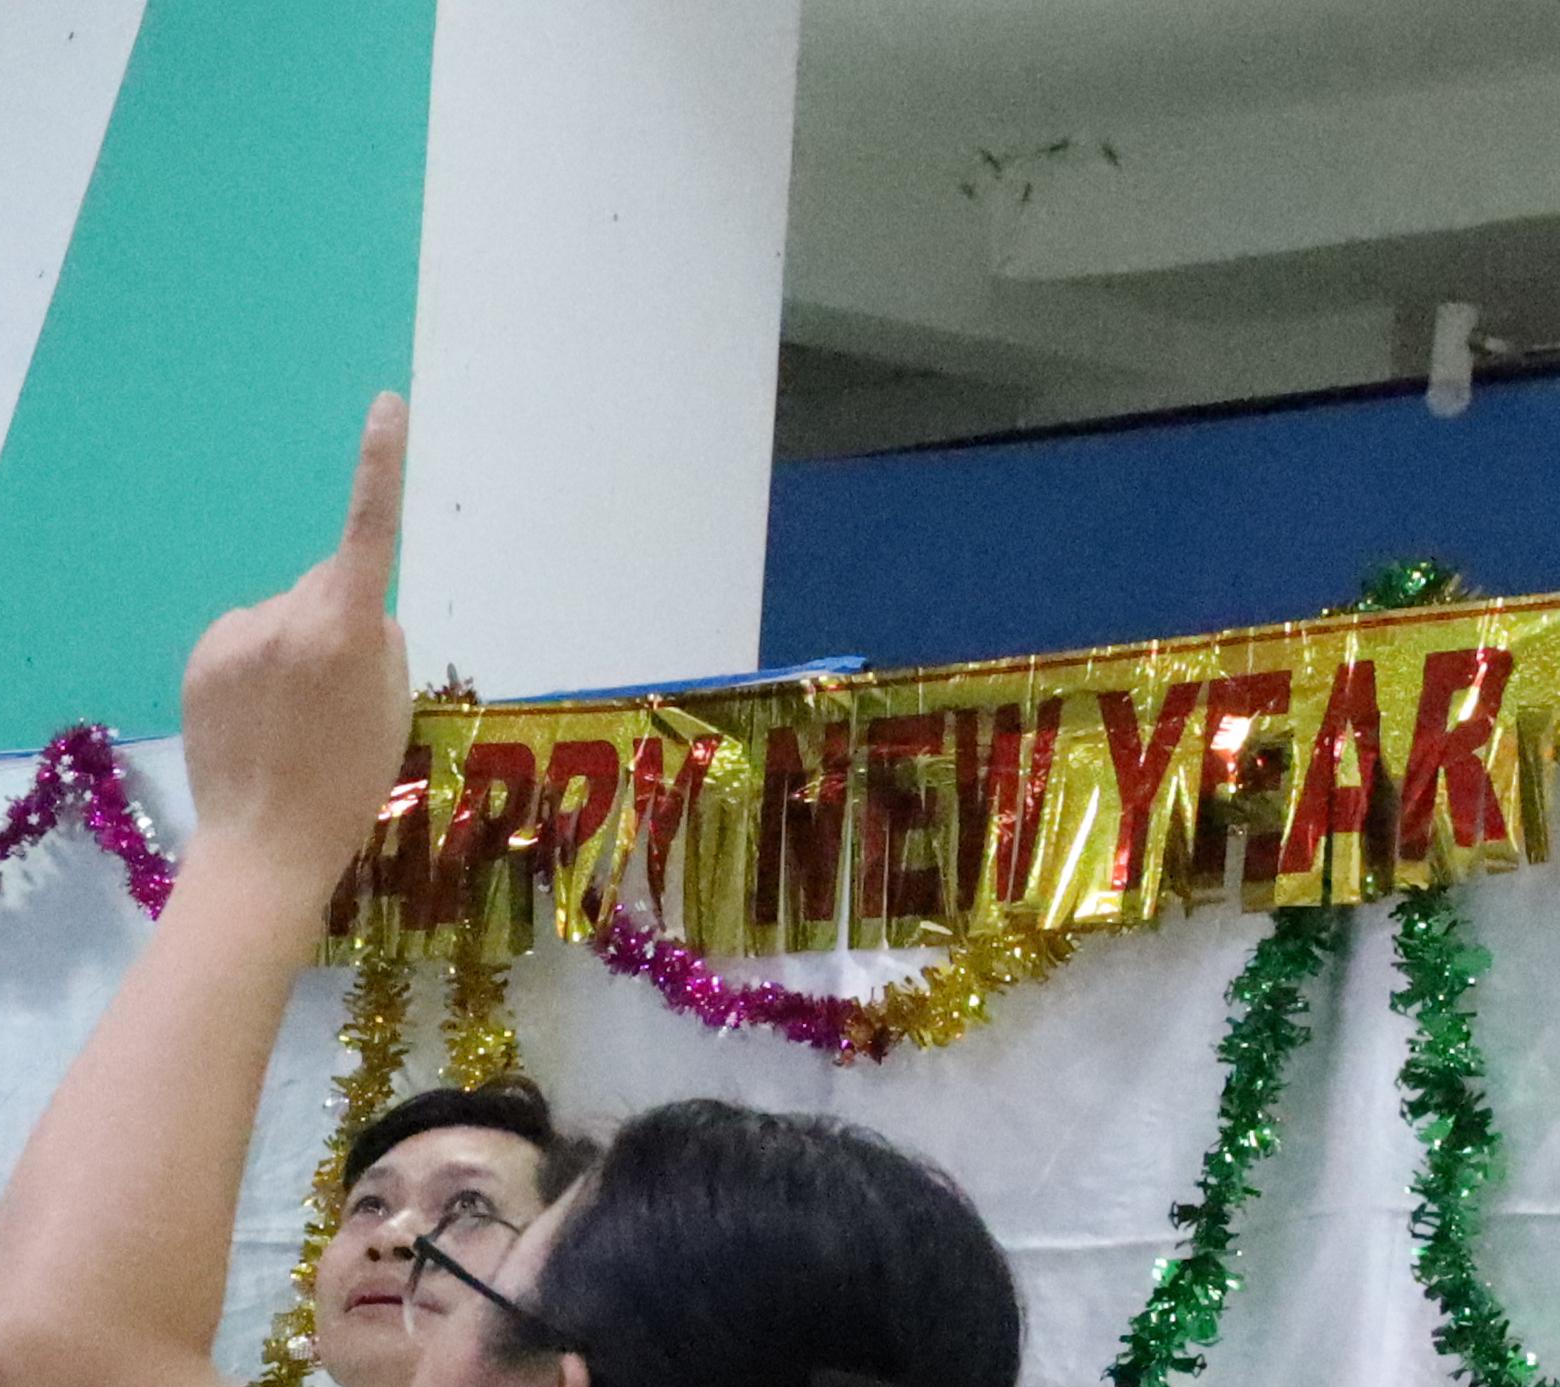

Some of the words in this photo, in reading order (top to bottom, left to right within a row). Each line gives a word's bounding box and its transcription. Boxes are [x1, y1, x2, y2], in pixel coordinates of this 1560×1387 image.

[327, 734, 724, 935] APPY
[754, 697, 1063, 925] NEW
[1096, 645, 1512, 891] YEAR
